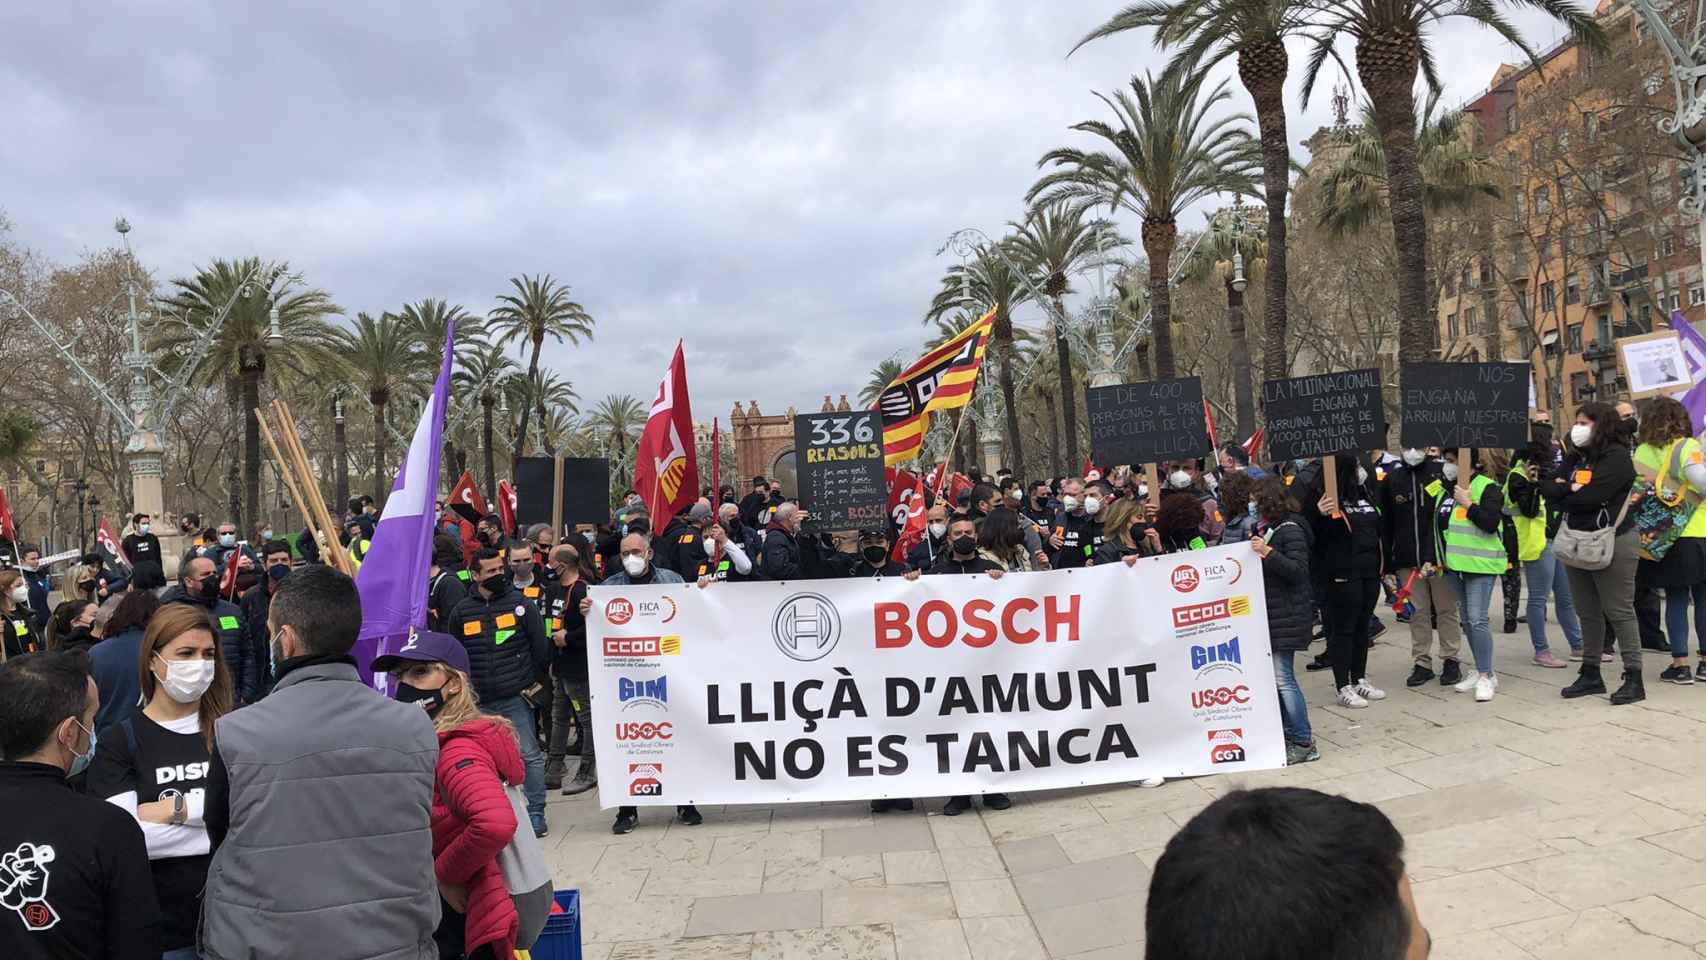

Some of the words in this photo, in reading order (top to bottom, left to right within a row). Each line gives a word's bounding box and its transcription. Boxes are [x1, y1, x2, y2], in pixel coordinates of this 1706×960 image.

[1478, 366, 1516, 384] NOS
[1115, 386, 1139, 404] DE
[1150, 382, 1183, 401] 400
[1264, 382, 1286, 403] LA
[1404, 408, 1457, 425] ARRUINA
[808, 415, 874, 446] 336
[1434, 423, 1499, 447] VIDAS
[806, 443, 881, 464] REASONS
[847, 502, 888, 520] BOSCH
[1174, 568, 1196, 582] UGT
[1204, 565, 1227, 577] FICA
[608, 602, 630, 614] UGT
[639, 602, 660, 612] FICA
[1176, 603, 1226, 624] CCOO
[873, 594, 1081, 649] BOSCH
[606, 640, 656, 653] CCOO
[1190, 636, 1242, 670] GIM
[618, 675, 667, 703] GIM
[706, 666, 868, 733] LLIÇÀ
[1191, 684, 1250, 710] USOC
[615, 722, 673, 741] USOC
[734, 737, 825, 781] NO
[847, 734, 909, 777] ES
[925, 722, 1139, 774] TANCA
[1214, 748, 1242, 761] CGT
[633, 783, 659, 794] CGT
